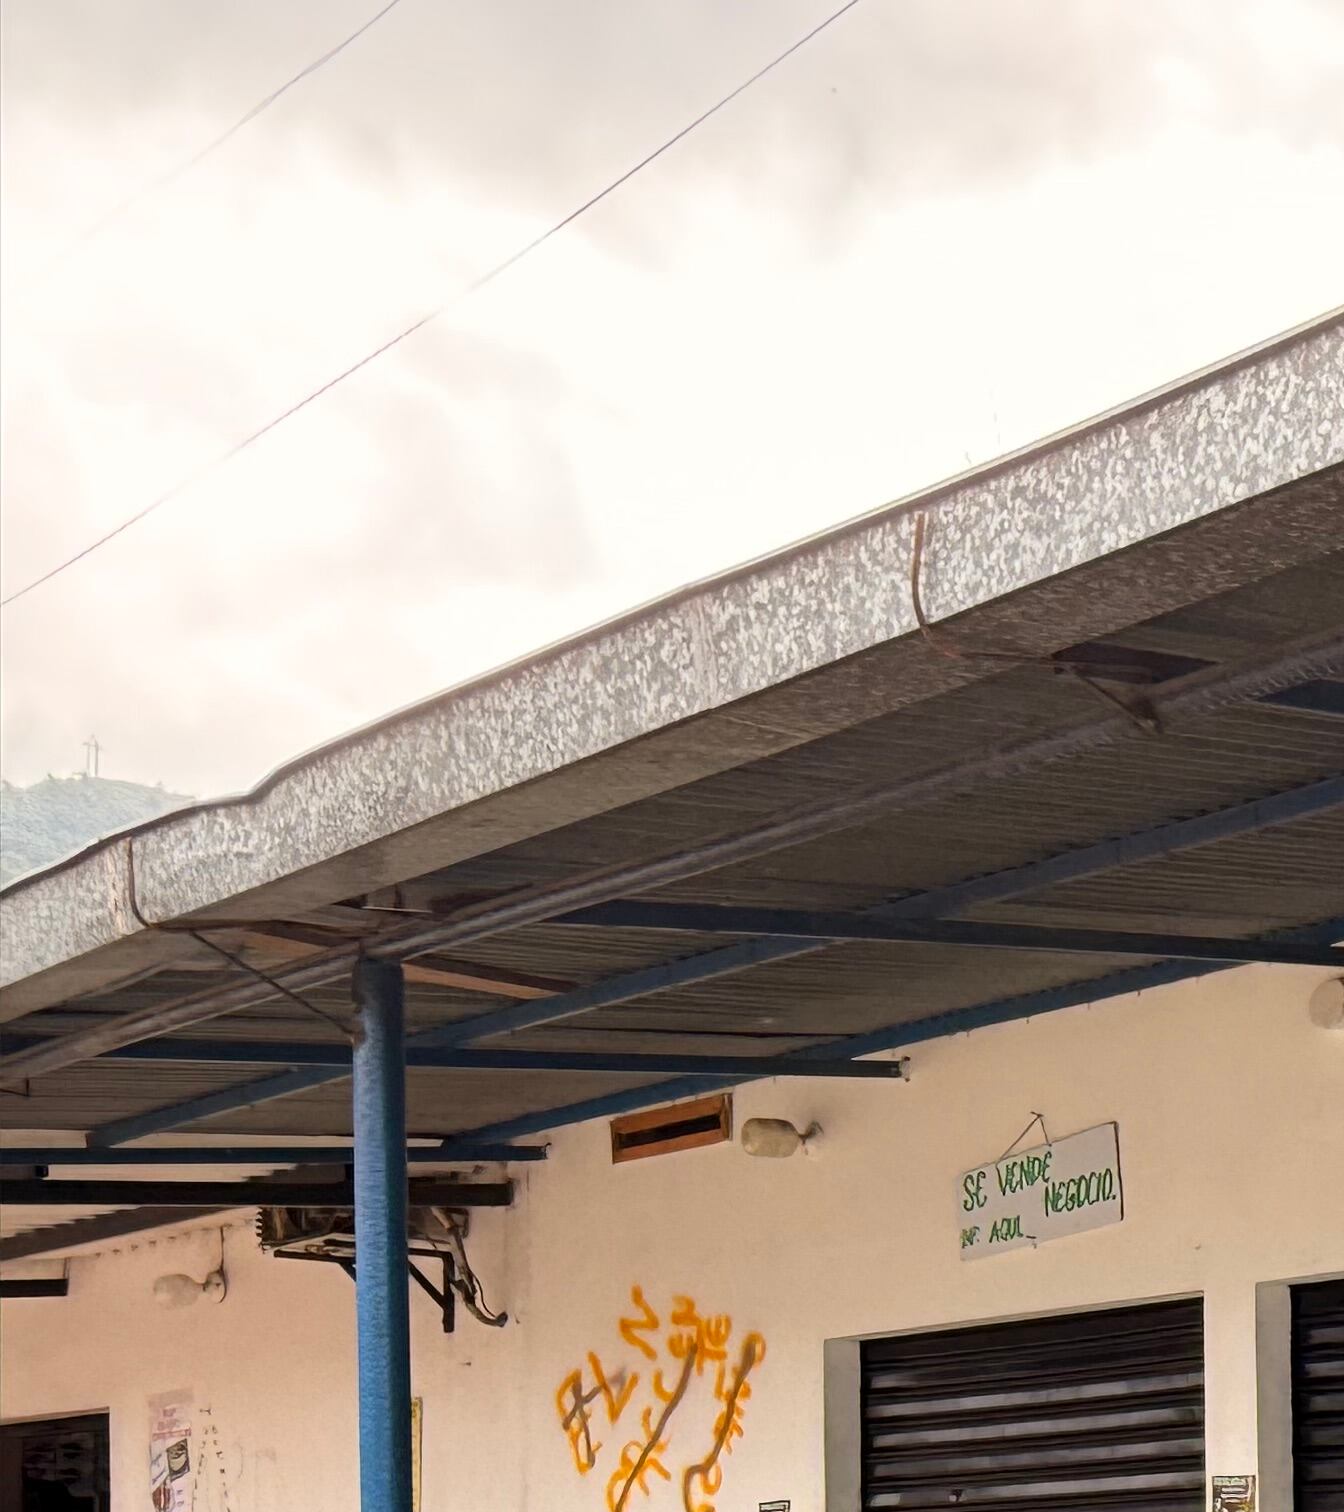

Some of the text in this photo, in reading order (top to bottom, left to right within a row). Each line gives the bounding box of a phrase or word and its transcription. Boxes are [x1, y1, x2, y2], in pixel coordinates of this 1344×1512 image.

[962, 1150, 1053, 1212] SE VENDE
[1044, 1168, 1117, 1217] NEGOCIO.
